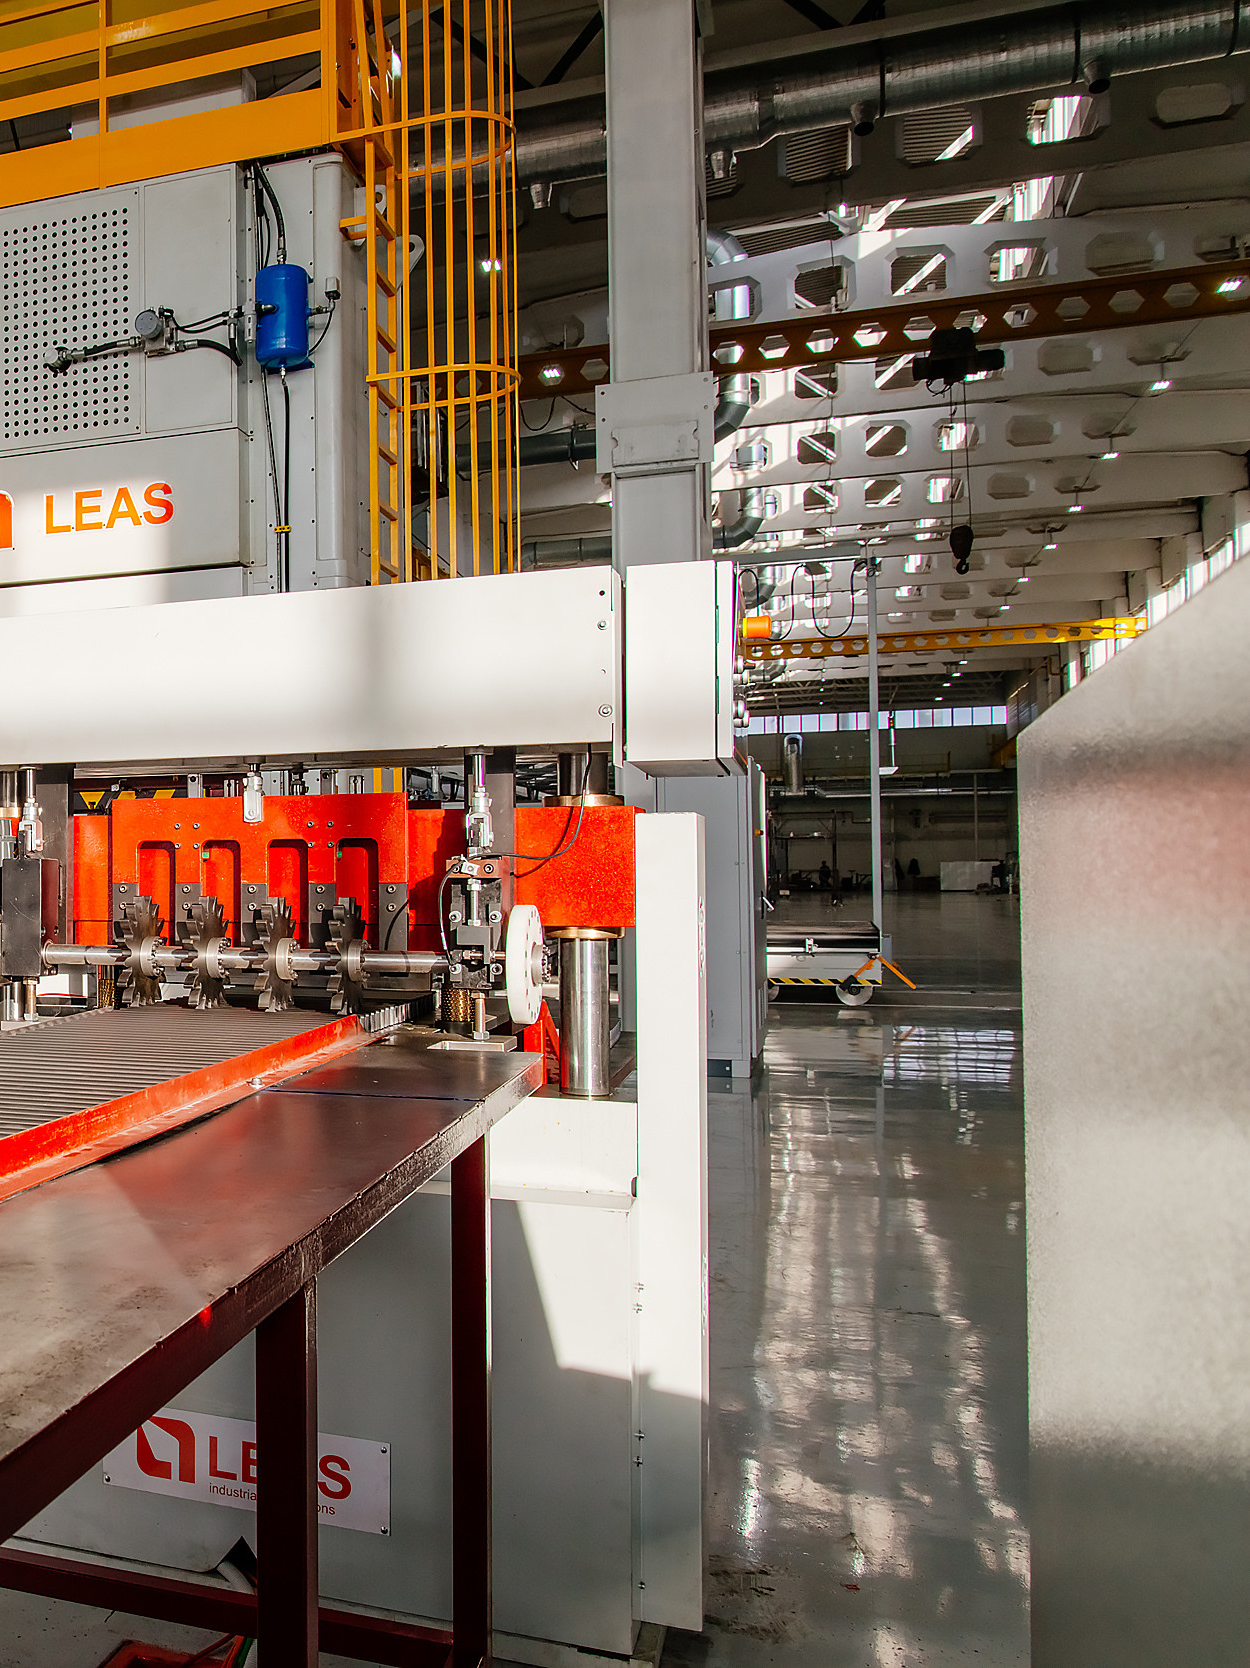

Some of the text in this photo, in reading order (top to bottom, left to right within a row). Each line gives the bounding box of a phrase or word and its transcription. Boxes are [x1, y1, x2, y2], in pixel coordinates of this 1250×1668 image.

[45, 482, 174, 534] LEAS
[209, 1436, 352, 1500] LES
[209, 1482, 257, 1501] industria
